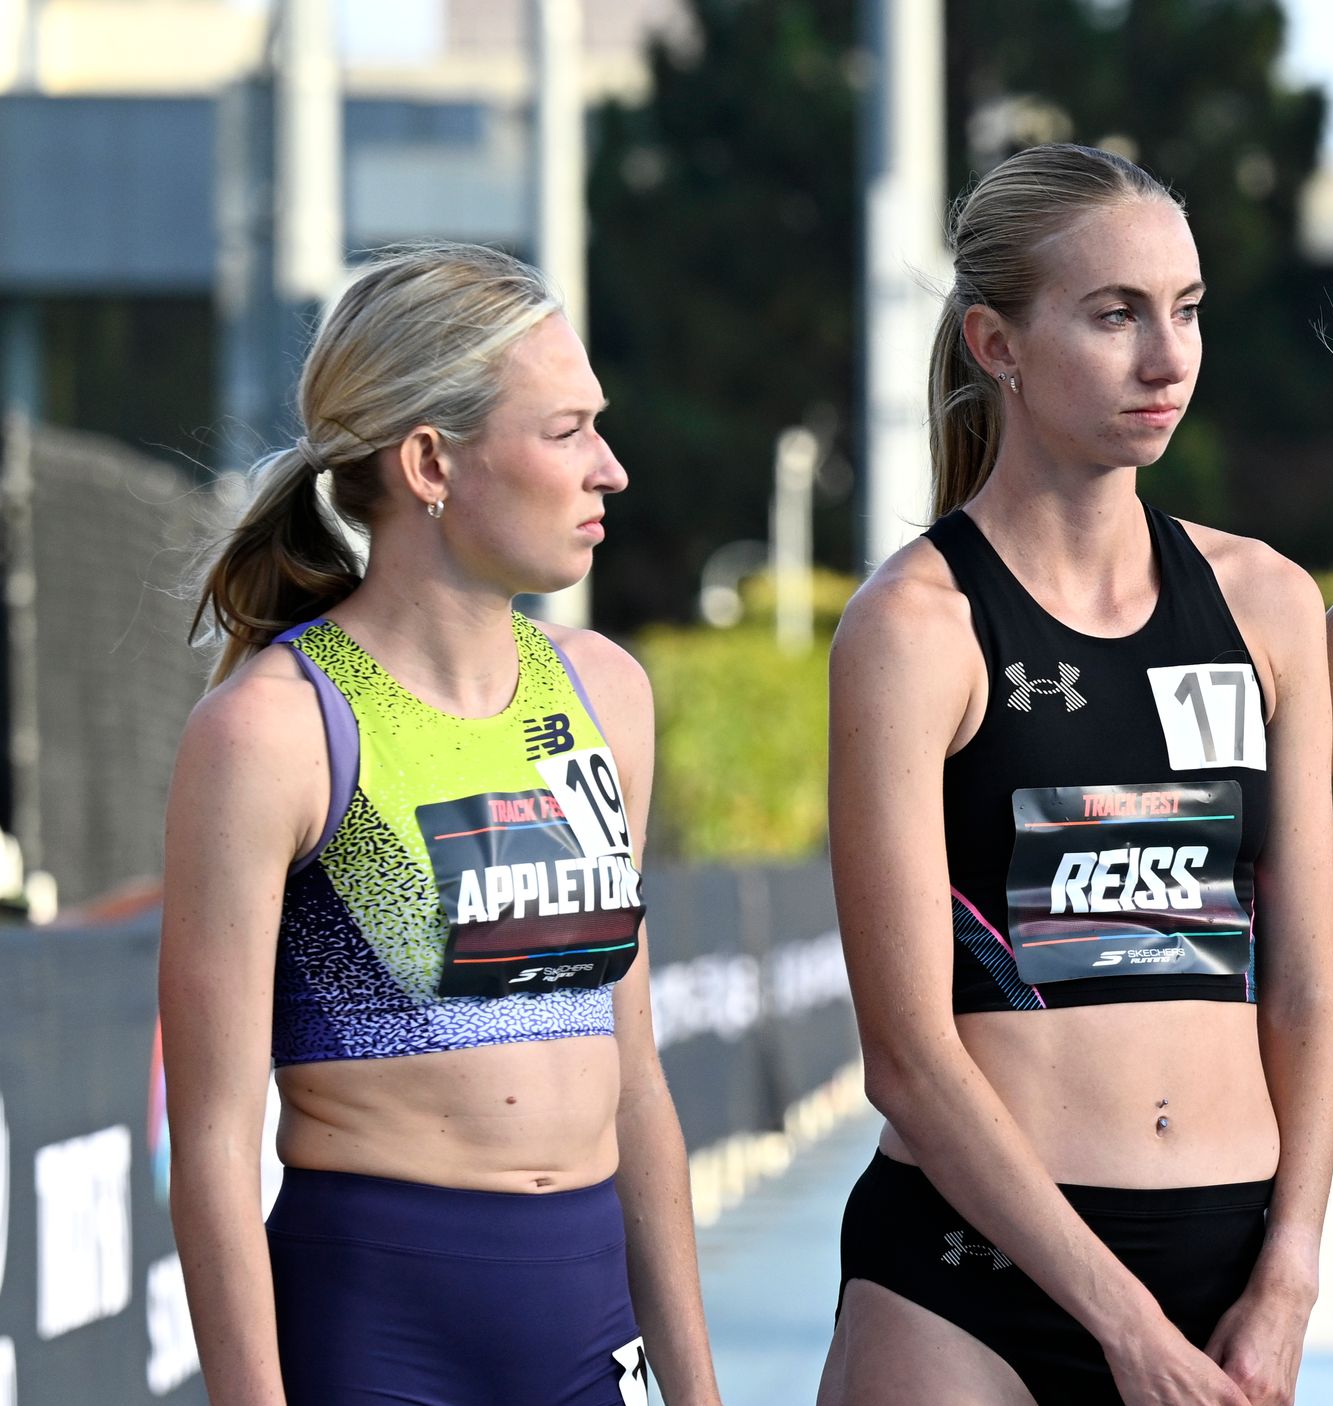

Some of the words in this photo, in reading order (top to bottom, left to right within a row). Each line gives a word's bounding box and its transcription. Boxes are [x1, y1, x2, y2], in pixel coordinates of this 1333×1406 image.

[1174, 671, 1246, 763] 17
[488, 798, 537, 822] TRACK
[540, 796, 566, 819] FES
[566, 754, 629, 847] 19
[1083, 793, 1137, 817] TRACK
[1140, 791, 1182, 815] FEST
[457, 856, 641, 924] APPLETON
[1050, 846, 1209, 915] REISS
